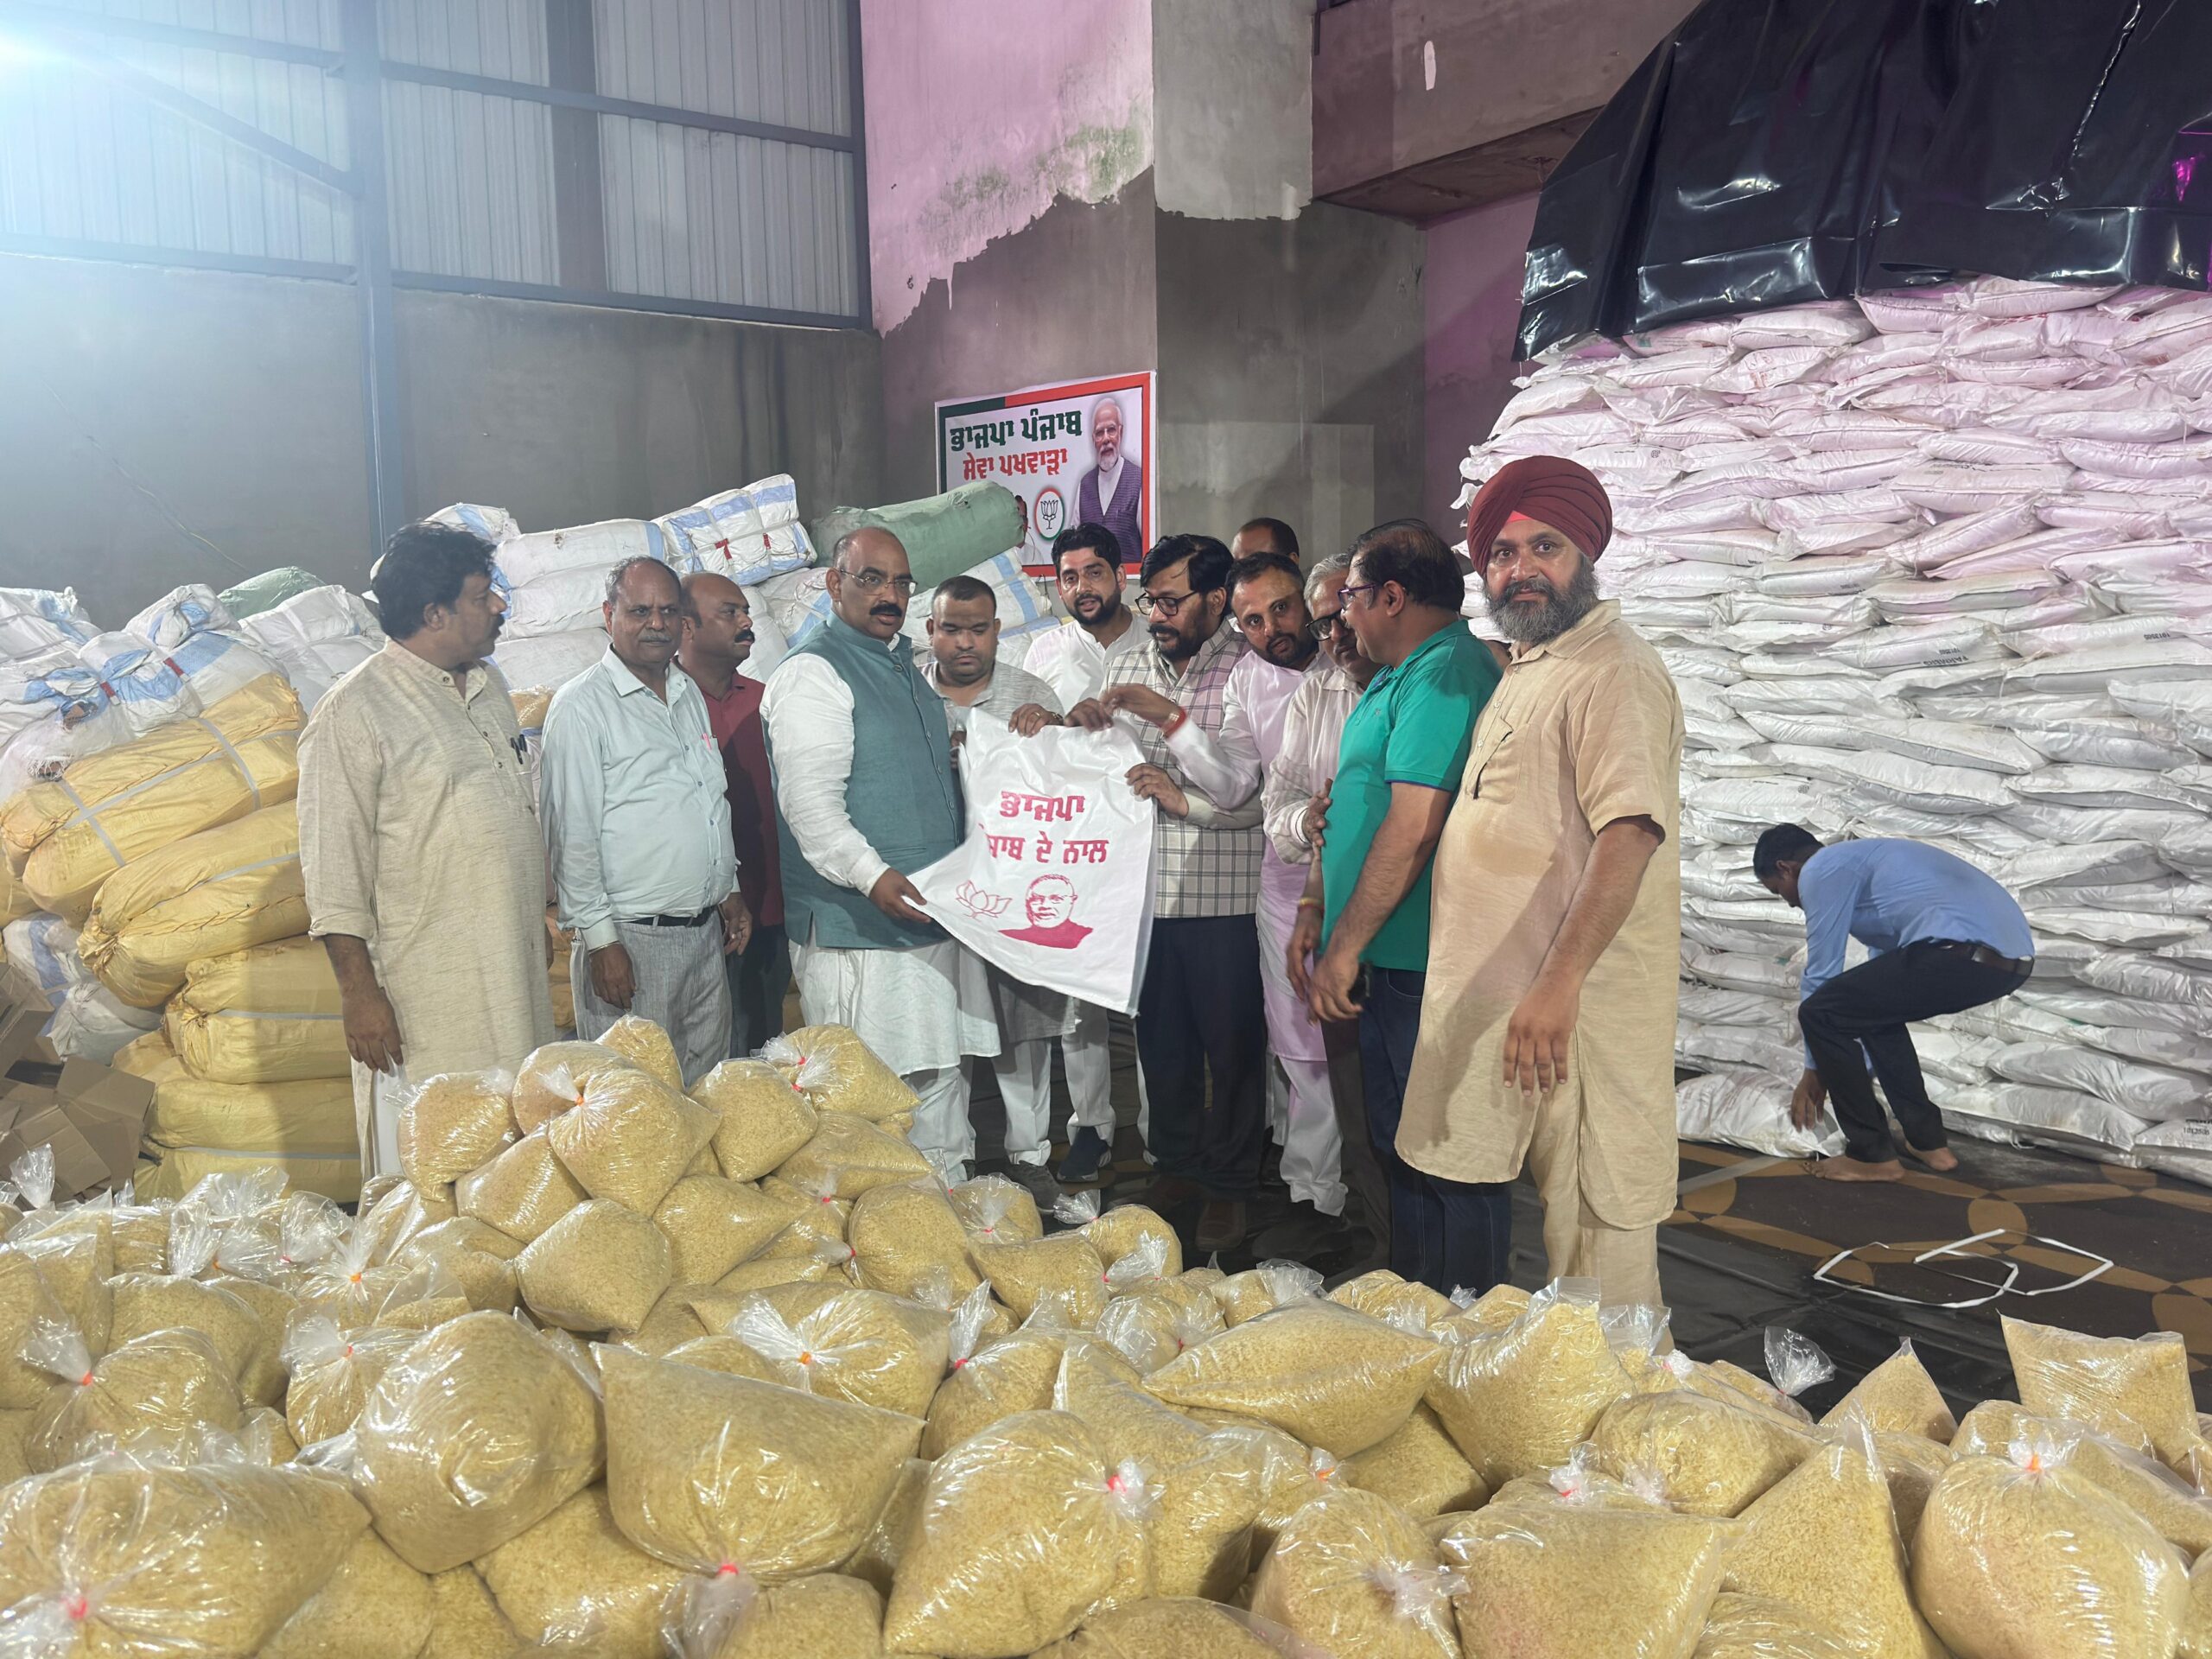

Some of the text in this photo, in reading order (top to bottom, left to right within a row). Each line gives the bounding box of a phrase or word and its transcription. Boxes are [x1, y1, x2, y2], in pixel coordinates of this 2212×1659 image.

[950, 409, 1082, 452] ਭਾਜਪਾ ਪੰਜਾਬ
[963, 448, 1068, 480] ਸੇਵਾ ਪਖਵਾੜਾ
[1000, 791, 1084, 822] ਭਾਜਪਾ
[1036, 830, 1053, 863] ਦੇ
[1063, 839, 1109, 864] ਨਾਲ
